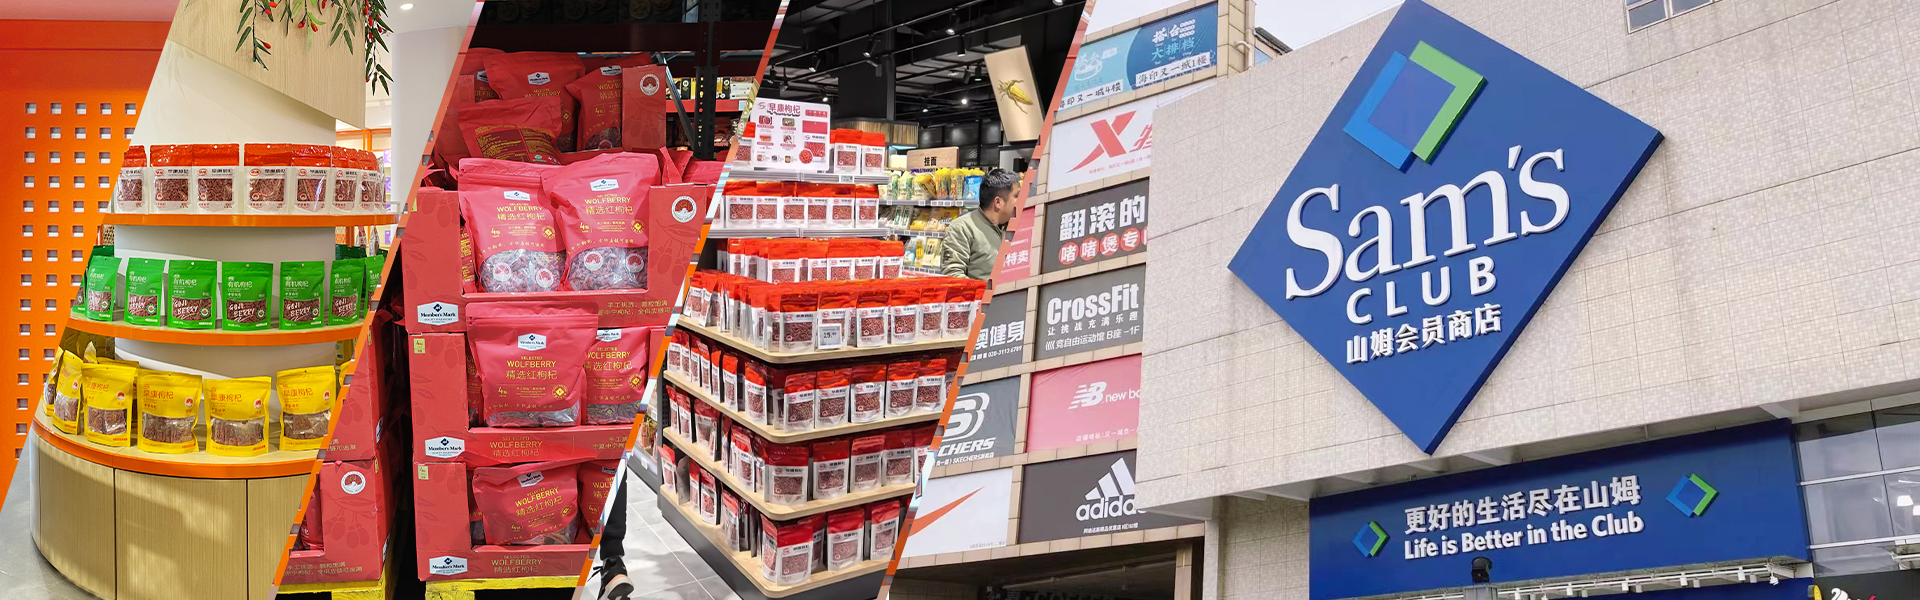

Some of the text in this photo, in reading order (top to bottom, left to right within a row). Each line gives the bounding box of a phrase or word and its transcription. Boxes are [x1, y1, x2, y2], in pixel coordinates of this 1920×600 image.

[1152, 37, 1195, 61] 大排档
[769, 103, 800, 114] 早康枸杞
[584, 197, 631, 205] WOLFBERRY
[585, 206, 634, 215] 精选红枸杞
[1059, 194, 1146, 241] 翻滚的
[1285, 144, 1570, 299] Sam's
[1003, 250, 1029, 267] 特卖
[1346, 256, 1498, 324] CLUB
[1046, 283, 1139, 325] CrossFit
[1047, 311, 1138, 336] 让挑战充满乐趣
[1346, 302, 1502, 364] 山姆会员商店
[506, 360, 557, 368] WOLFBERRY
[506, 370, 557, 380] 精选红枸杞
[489, 441, 543, 449] WOLFBERRY
[492, 449, 540, 457] 精选红枸杞
[938, 437, 996, 457] CHERS
[514, 486, 559, 507] WOLFBERRY
[515, 496, 563, 517] 精选红枸杞
[1405, 475, 1642, 535] 更好的生活尽在山姆
[1076, 494, 1147, 521] adida
[1404, 510, 1645, 559] Life is Better in the Club
[491, 558, 542, 566] WOLFBERRY
[493, 566, 539, 574] 精选红枸杞
